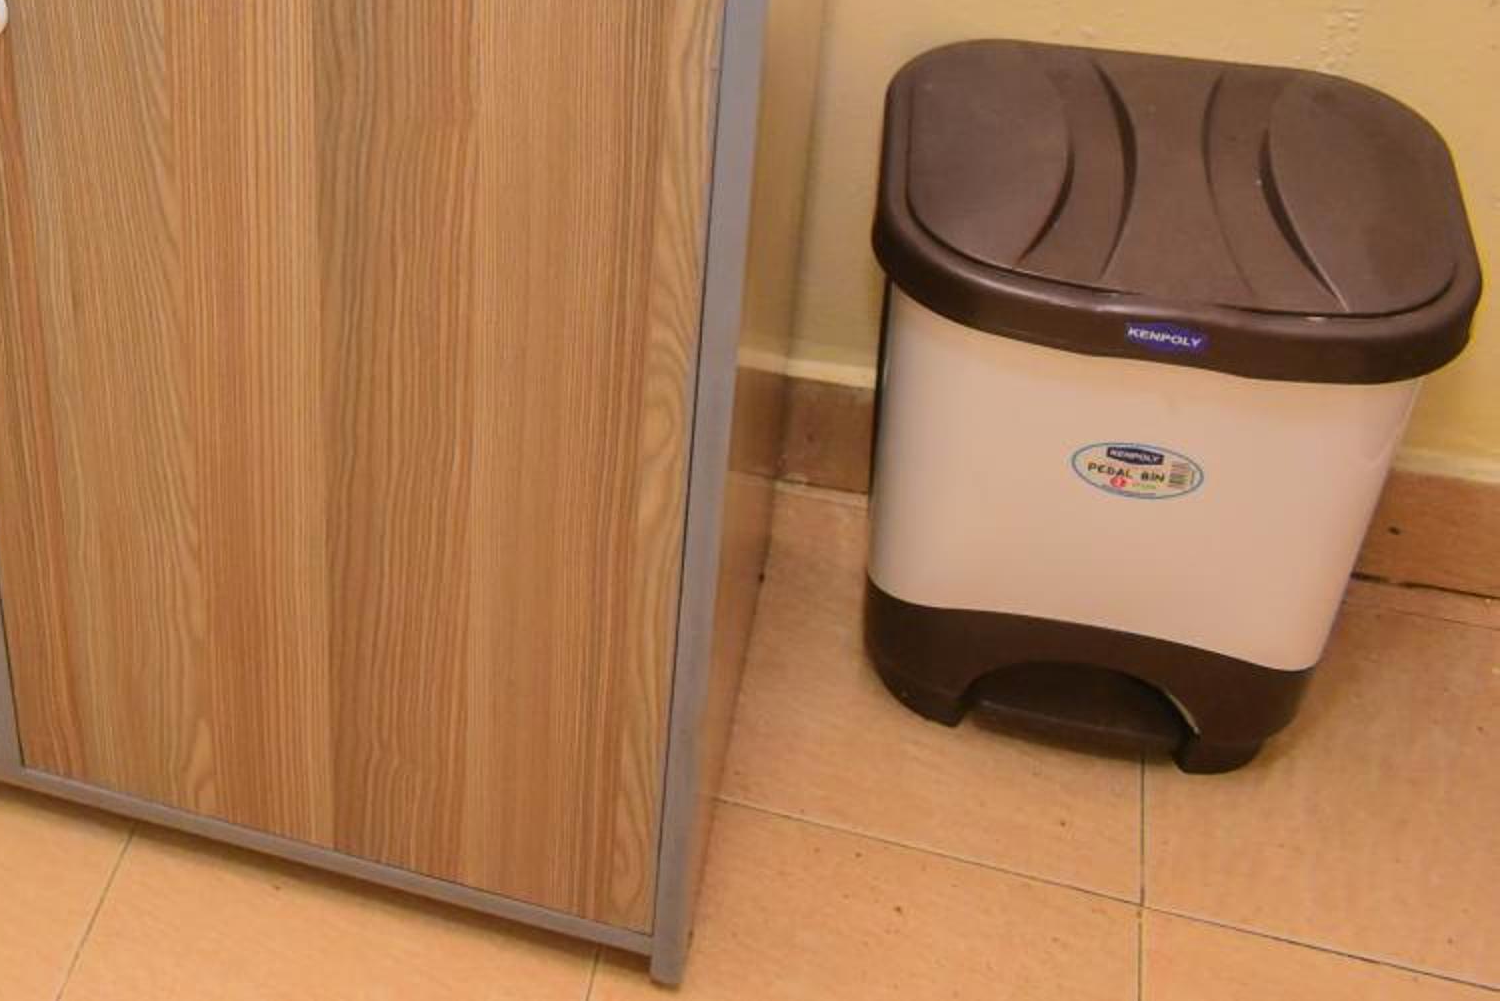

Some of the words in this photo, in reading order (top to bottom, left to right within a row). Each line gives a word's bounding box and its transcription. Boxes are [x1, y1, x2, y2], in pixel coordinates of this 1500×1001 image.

[1126, 326, 1202, 349] KENPOLY
[1087, 461, 1134, 479] PEDAL
[1139, 470, 1165, 483] BIN
